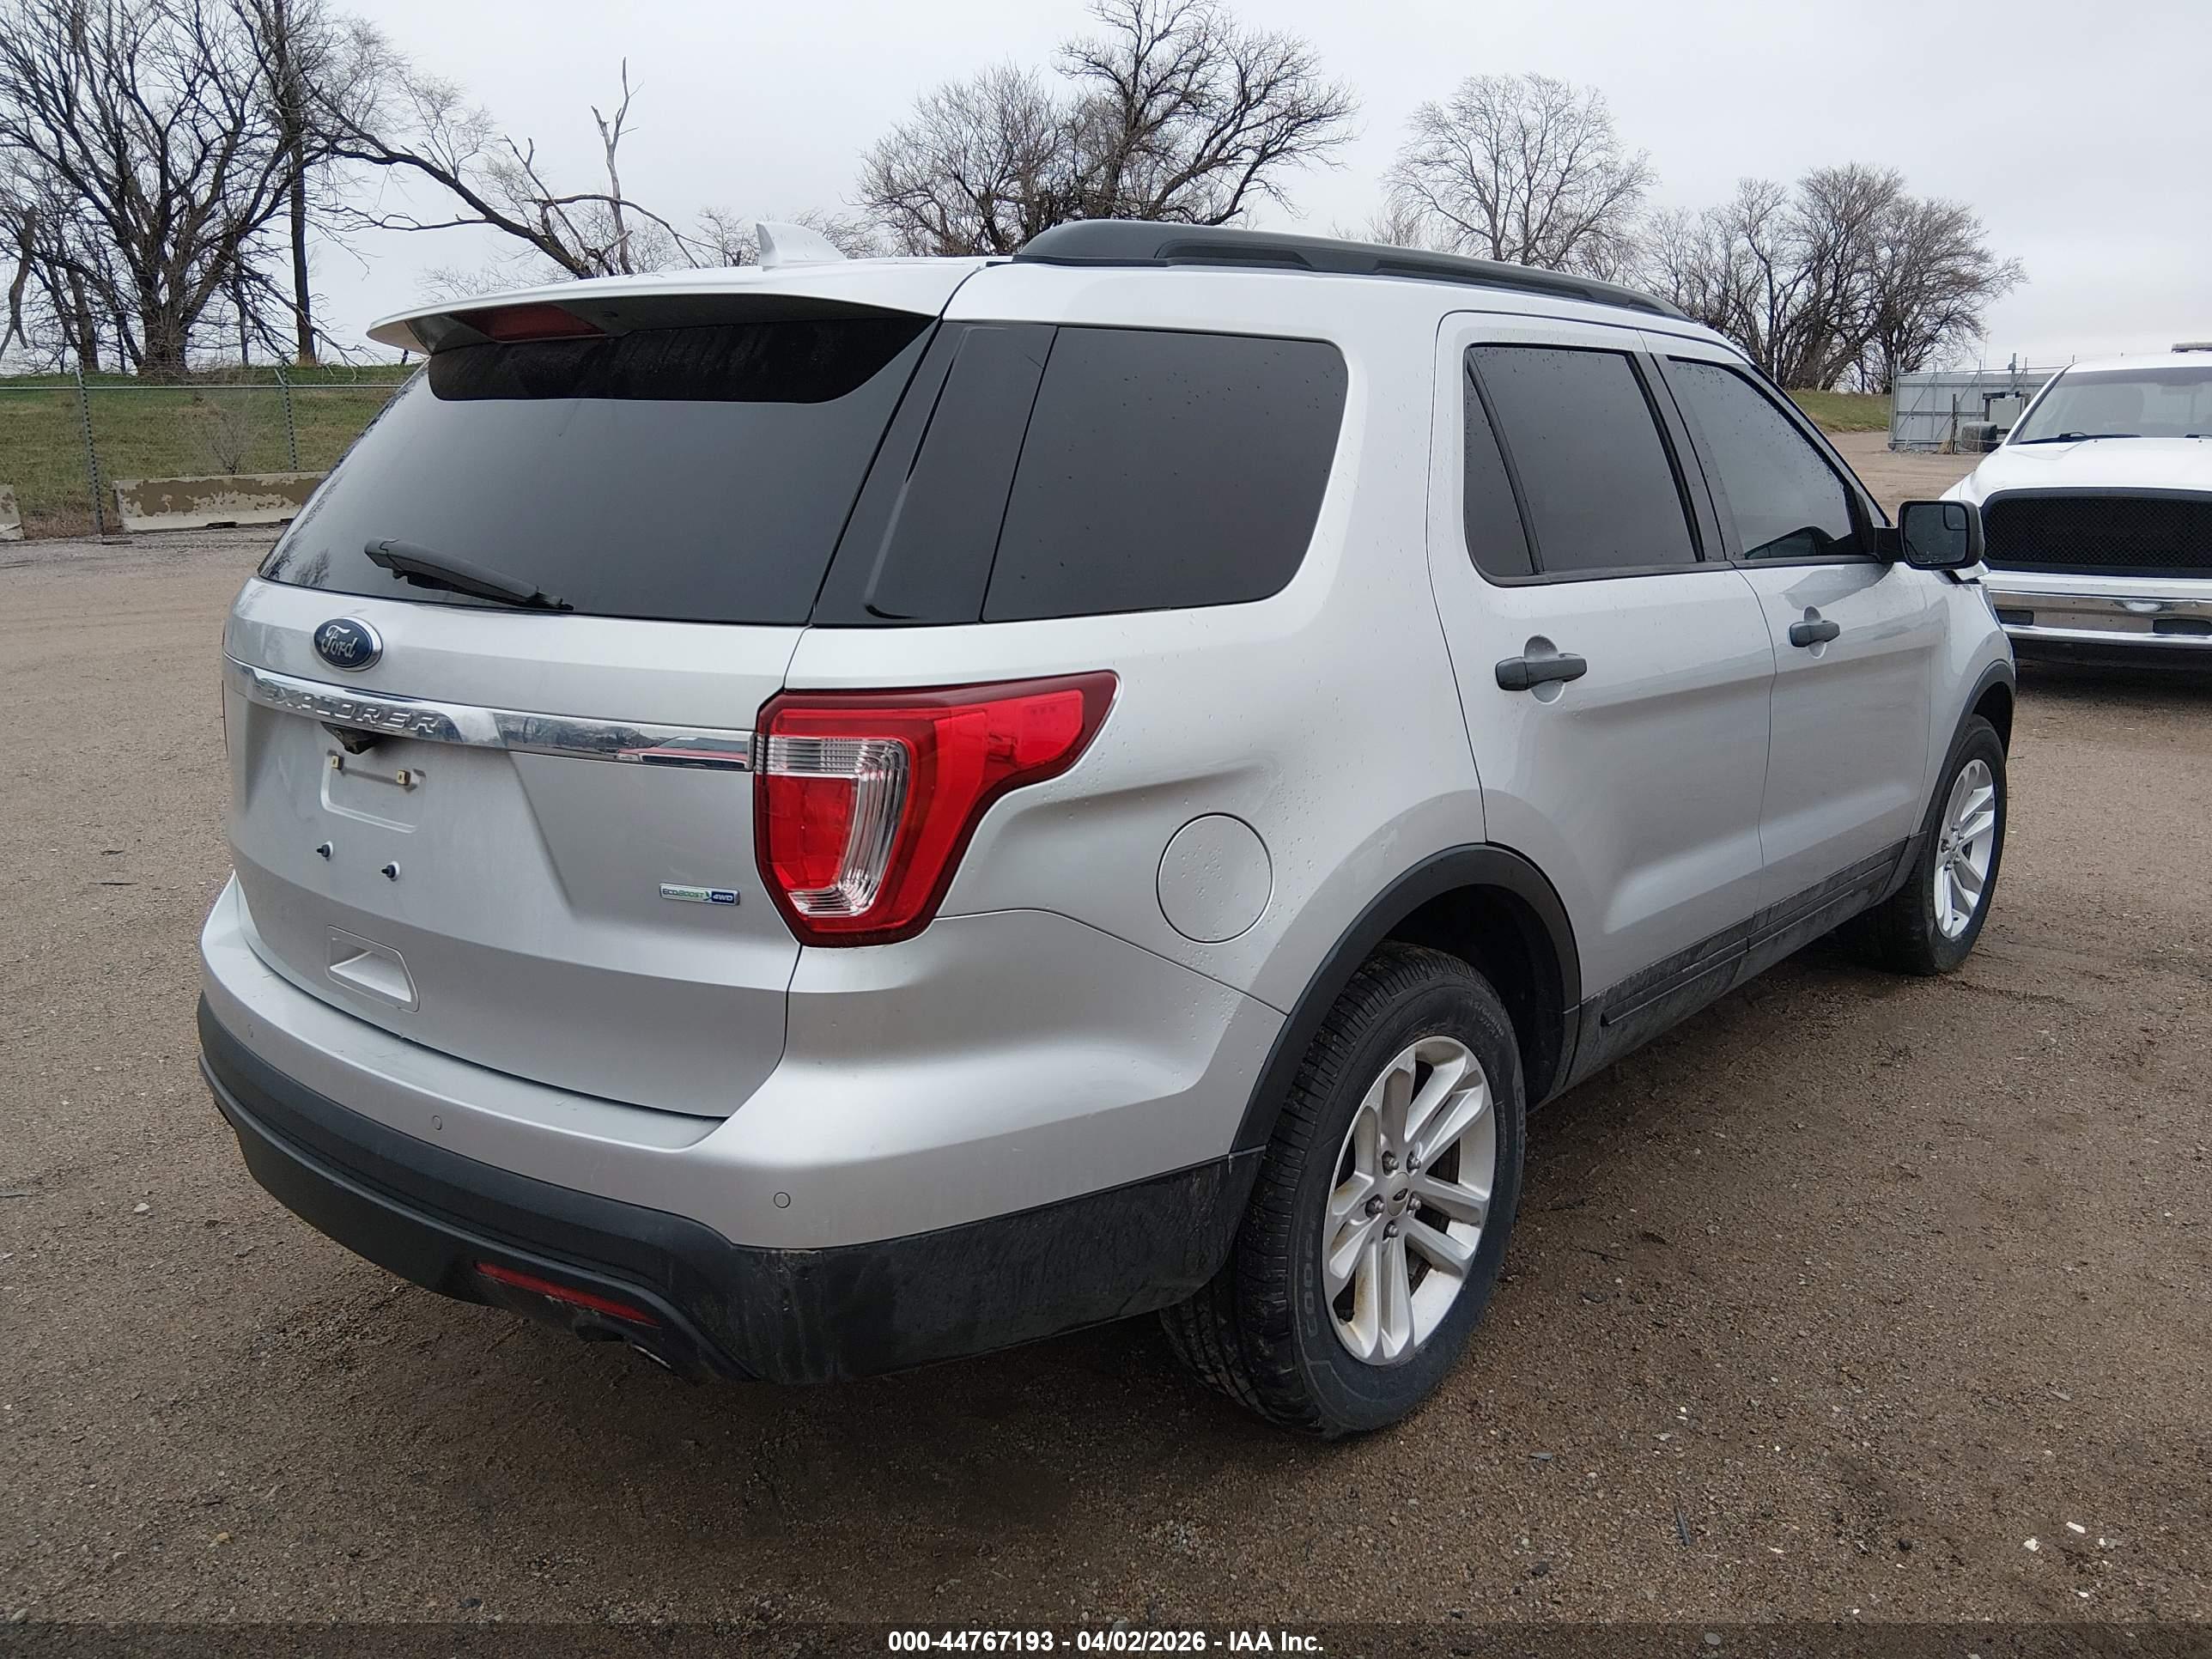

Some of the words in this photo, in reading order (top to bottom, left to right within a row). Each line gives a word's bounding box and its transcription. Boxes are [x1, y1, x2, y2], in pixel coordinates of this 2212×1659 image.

[321, 624, 358, 659] Ford
[257, 684, 440, 734] EXPLORER
[712, 893, 733, 902] 4WD
